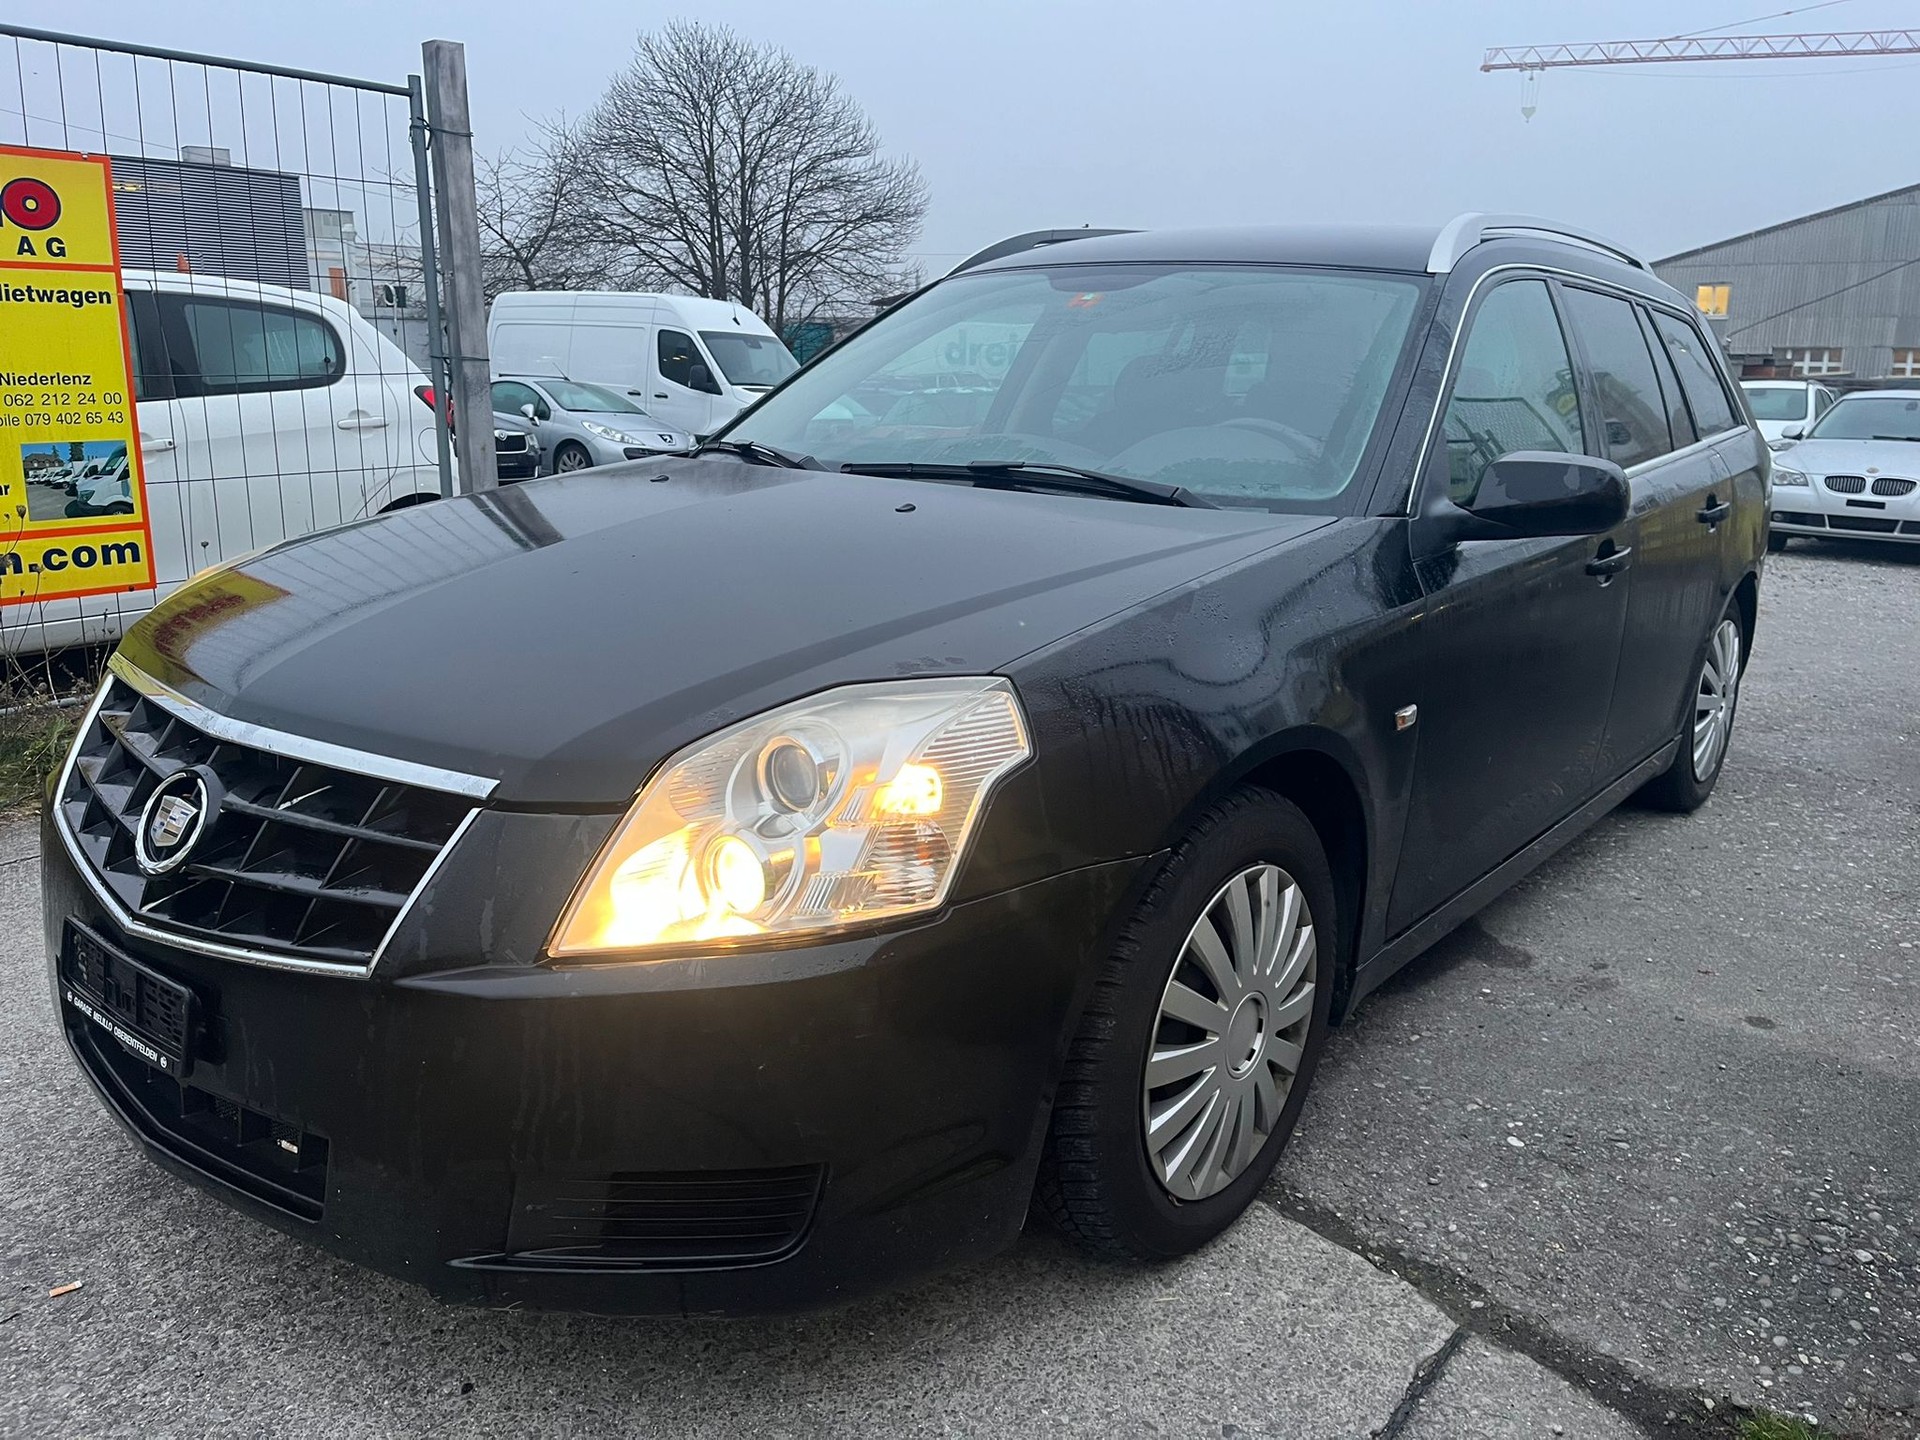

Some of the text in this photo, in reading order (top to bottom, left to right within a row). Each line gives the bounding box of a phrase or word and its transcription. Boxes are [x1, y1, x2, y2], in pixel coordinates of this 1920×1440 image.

[0, 284, 111, 308] ietwagen
[0, 372, 92, 386] Niederlenz
[4, 392, 122, 407] 062 212 24 00
[25, 413, 51, 426] 079
[56, 412, 82, 425] 402
[86, 412, 103, 424] 65
[108, 411, 124, 424] 43
[74, 997, 92, 1016] GARAGE
